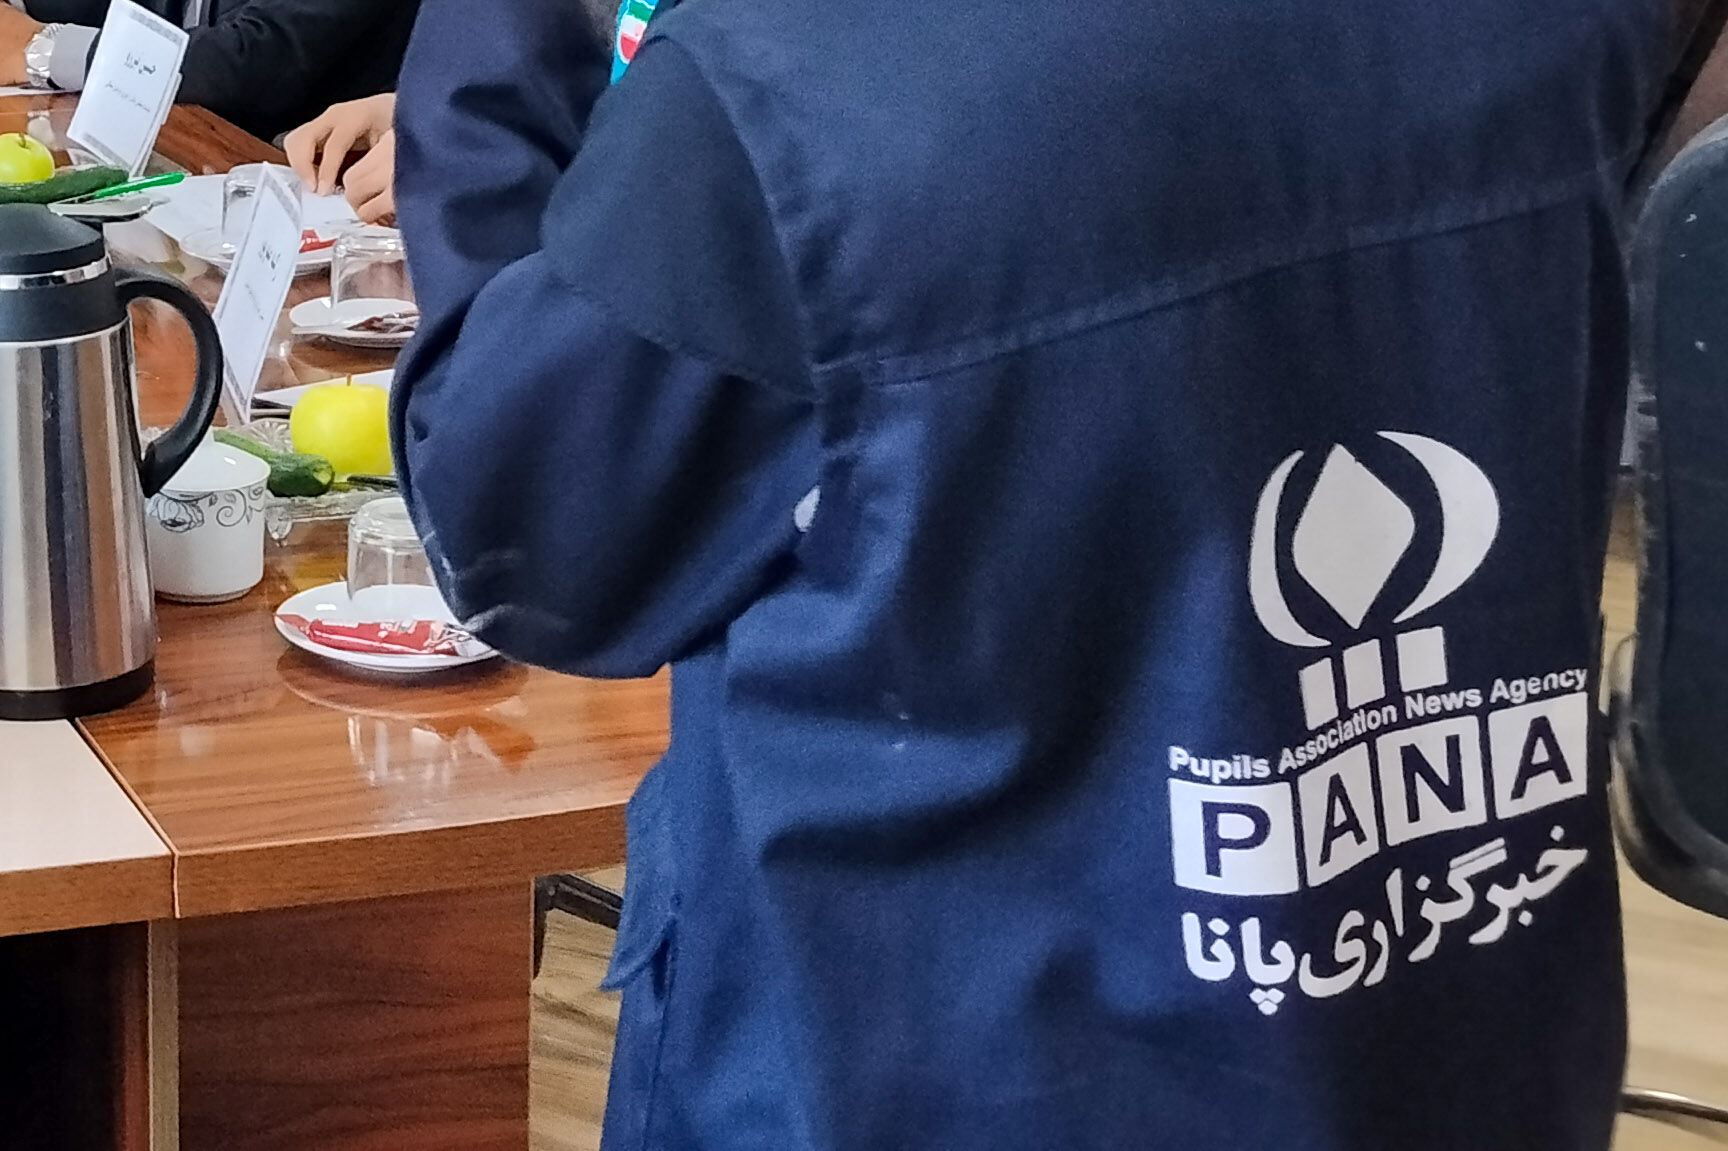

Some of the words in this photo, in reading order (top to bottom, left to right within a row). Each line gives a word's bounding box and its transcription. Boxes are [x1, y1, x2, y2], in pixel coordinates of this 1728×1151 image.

[1169, 745, 1270, 782] Pupils
[1278, 704, 1397, 774] Association
[1404, 686, 1482, 721] News
[1489, 668, 1588, 703] Agency
[1198, 714, 1575, 879] PANA
[1181, 911, 1295, 1016] پانا
[1298, 825, 1588, 998] خبرگزاری
